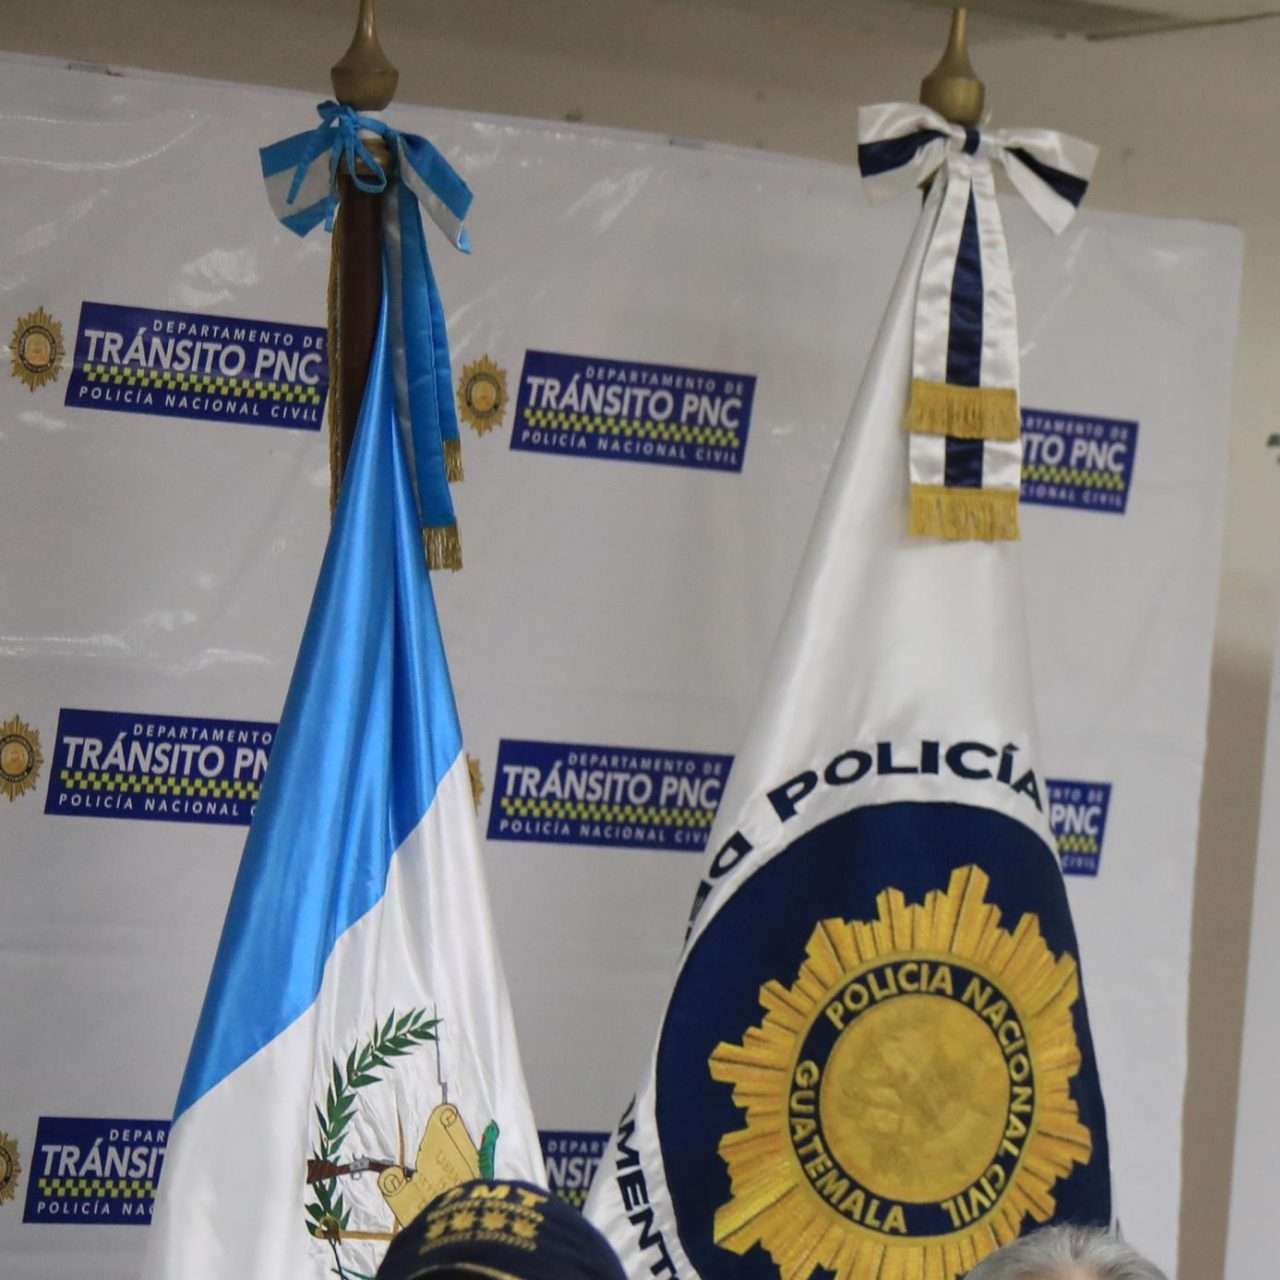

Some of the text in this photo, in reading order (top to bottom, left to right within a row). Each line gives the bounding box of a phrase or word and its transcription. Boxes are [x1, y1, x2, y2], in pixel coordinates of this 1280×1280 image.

[153, 320, 323, 348] DEPARTAMENTO DE
[84, 327, 322, 384] TRÁNSITO PNC
[586, 365, 743, 395] DEPARTAMENTO DE
[79, 385, 318, 422] POLICÍA NACIONAL CIVIL
[526, 373, 742, 429] TRÁNSITO PNC
[521, 430, 737, 465] POLICÍA NACIONAL CIVIL
[1070, 439, 1127, 472] PNC
[133, 723, 272, 744] DEPARTAMENTO
[63, 732, 268, 780] TRÁNSITO PN
[568, 752, 723, 775] DEPARTAMENTO DE
[503, 761, 721, 809] TRÁNSITO PNC
[767, 741, 1043, 824] POLICÍA
[58, 793, 133, 810] POLICÍA
[145, 799, 239, 816] NACIONAL
[1051, 803, 1101, 835] PNC
[500, 818, 709, 844] POLICÍA NACIONAL CIVI
[825, 961, 1033, 1228] POLICIA NACIONAL CIVIL
[41, 1138, 167, 1178] TRÁNSI
[790, 1059, 908, 1233] GUATEMALA
[37, 1200, 110, 1215] POLICÍA
